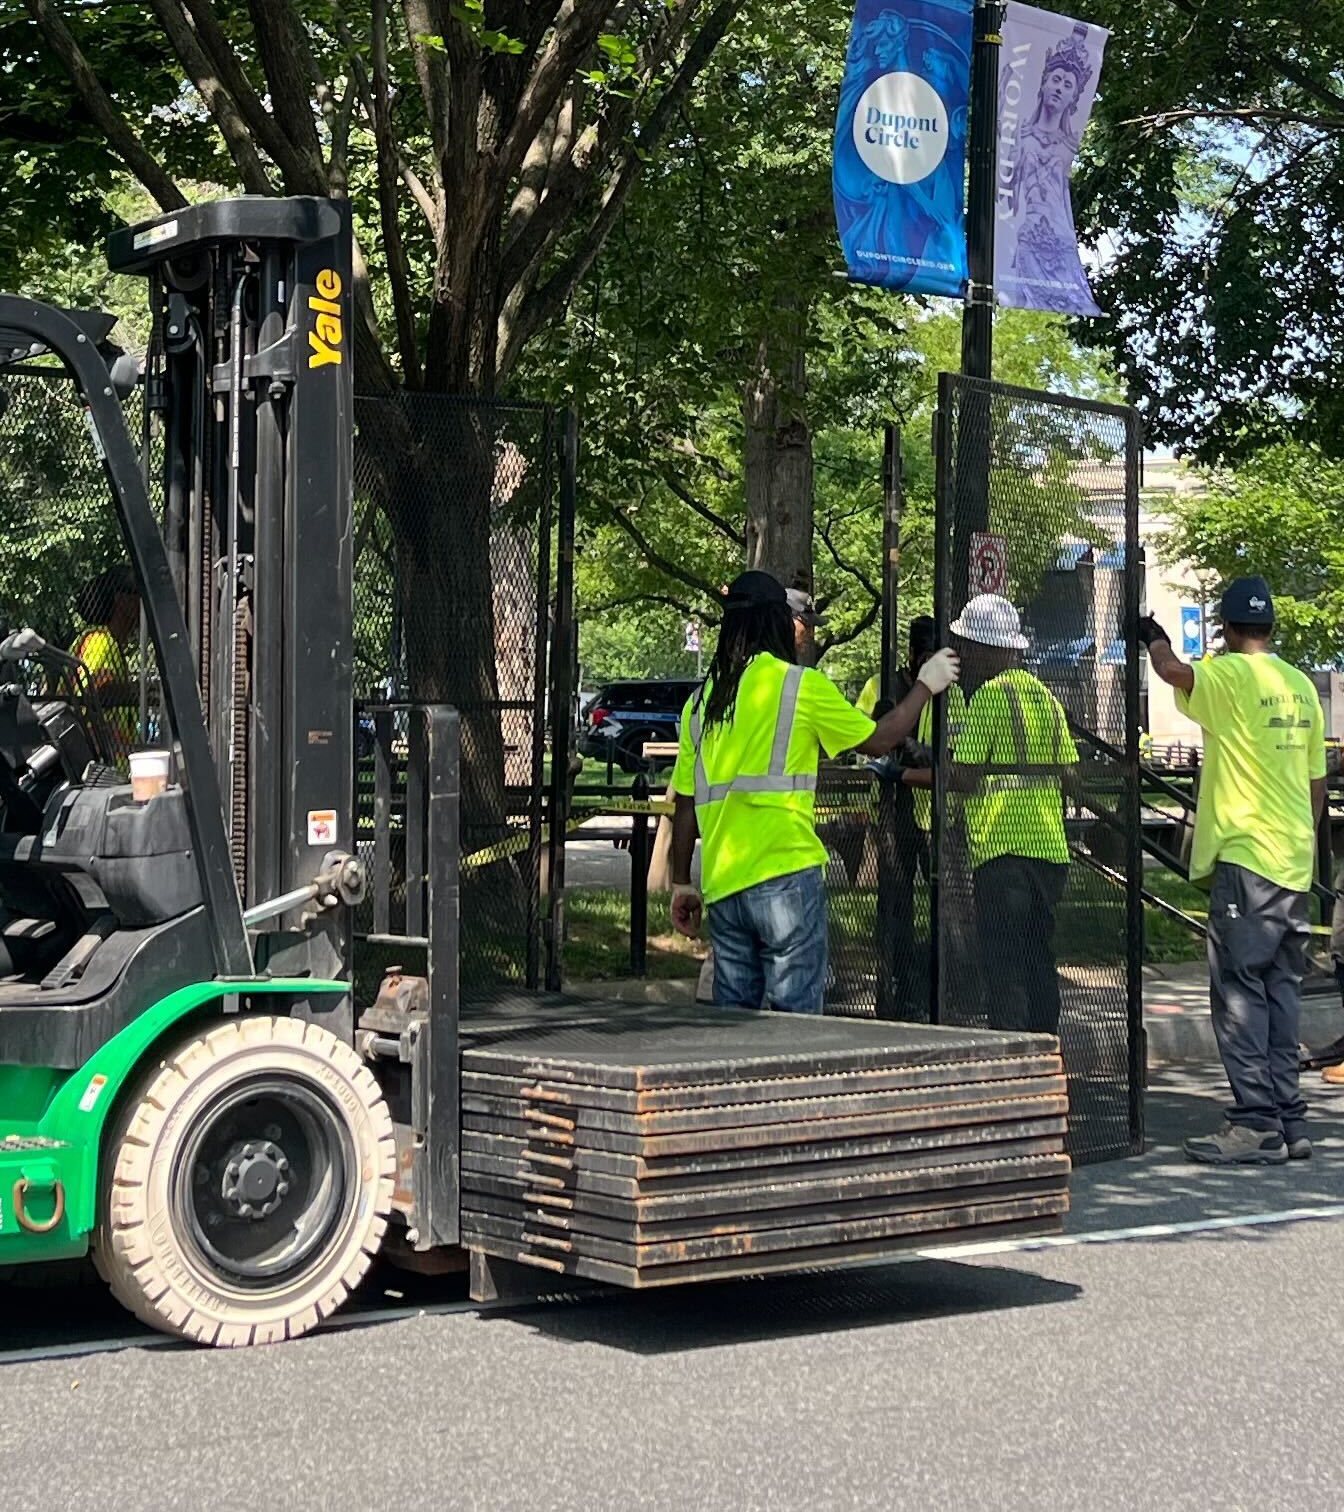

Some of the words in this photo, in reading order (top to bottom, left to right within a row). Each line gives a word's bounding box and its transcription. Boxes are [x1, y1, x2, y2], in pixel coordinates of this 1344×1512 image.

[866, 107, 938, 132] Dupont
[865, 127, 920, 149] Circle
[308, 269, 342, 369] Yale
